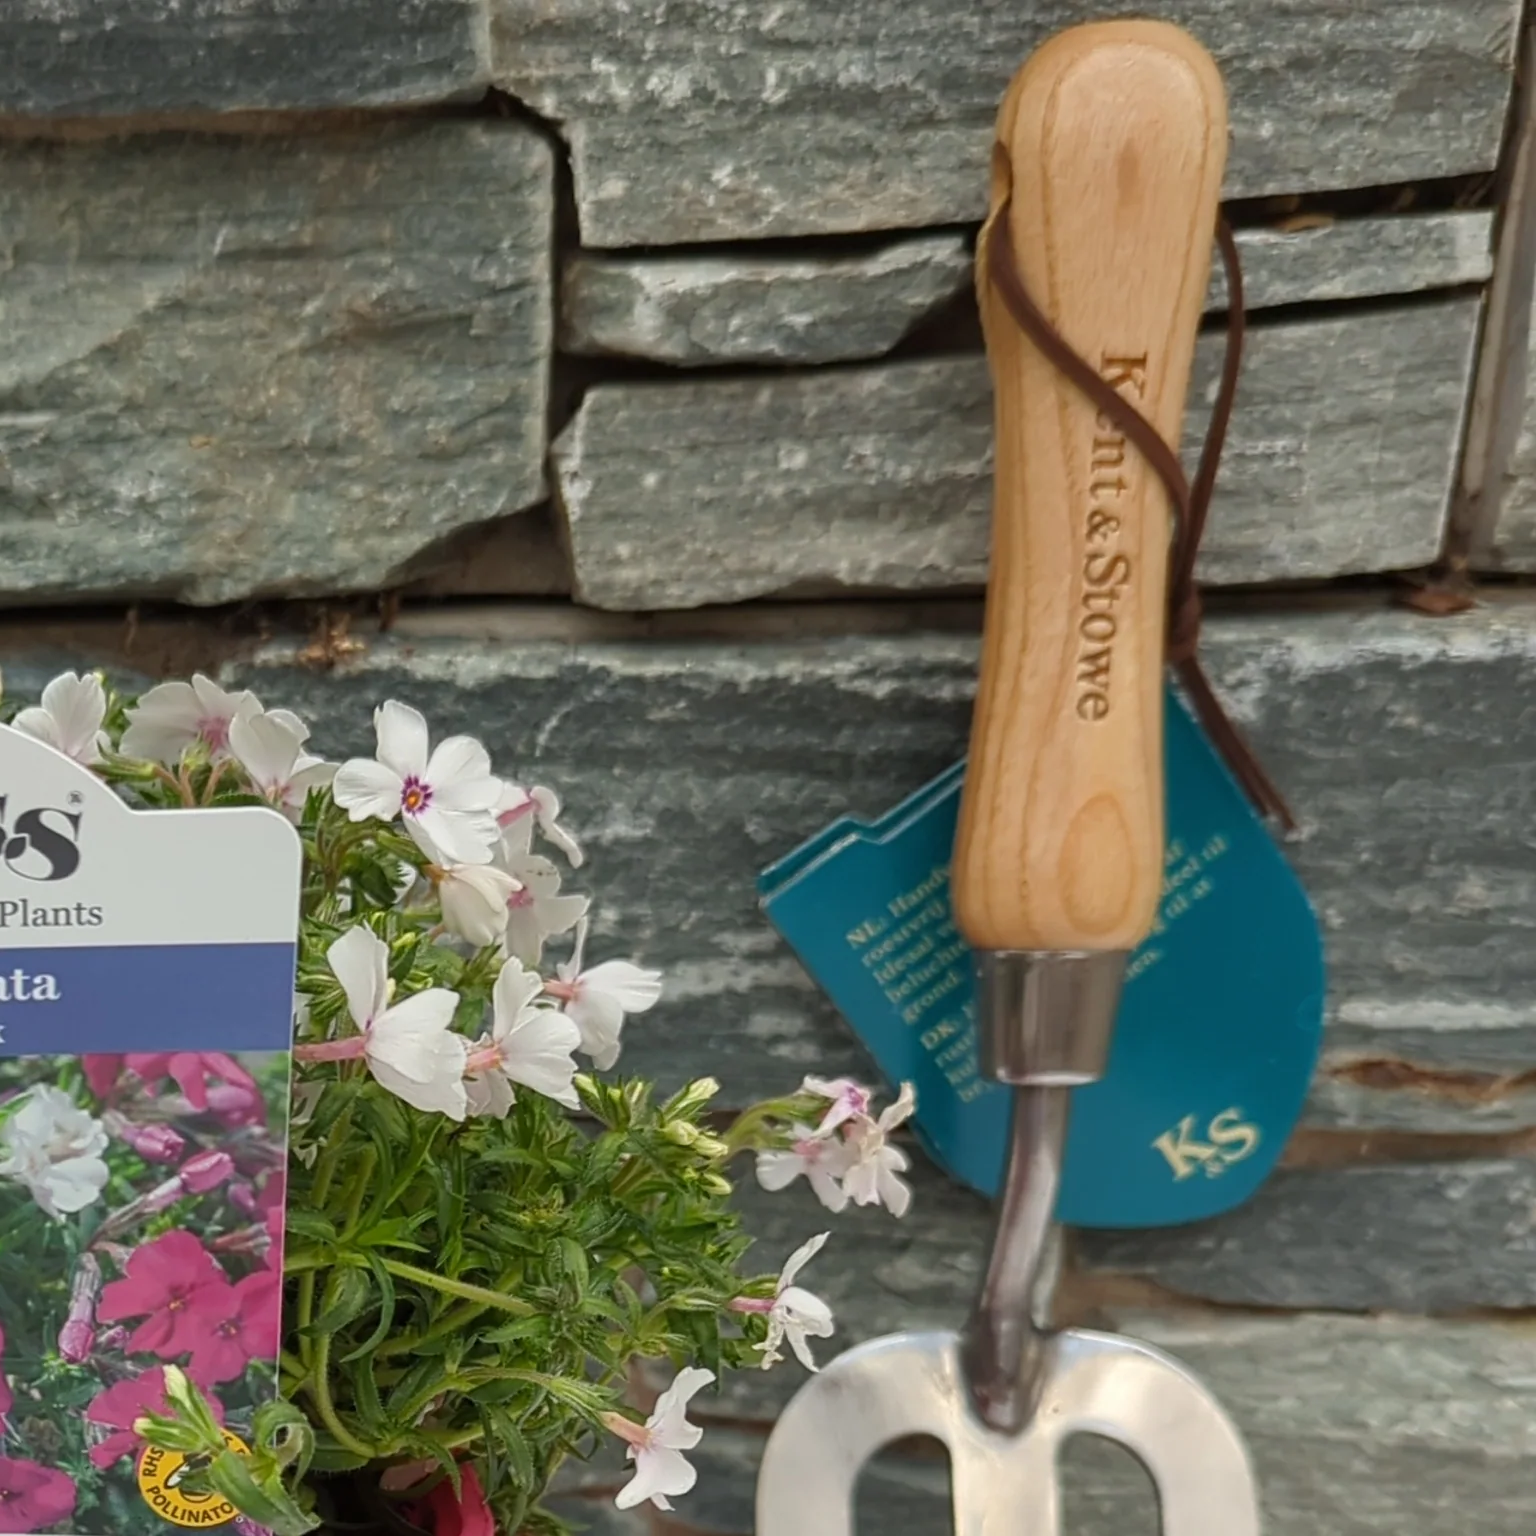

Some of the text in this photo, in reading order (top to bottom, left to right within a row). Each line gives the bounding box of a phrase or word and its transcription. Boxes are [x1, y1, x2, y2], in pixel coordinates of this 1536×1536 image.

[1084, 508, 1121, 545] &
[1075, 551, 1132, 723] Stowe
[142, 1447, 165, 1478] RHS
[146, 1485, 234, 1523] POLLINATO
